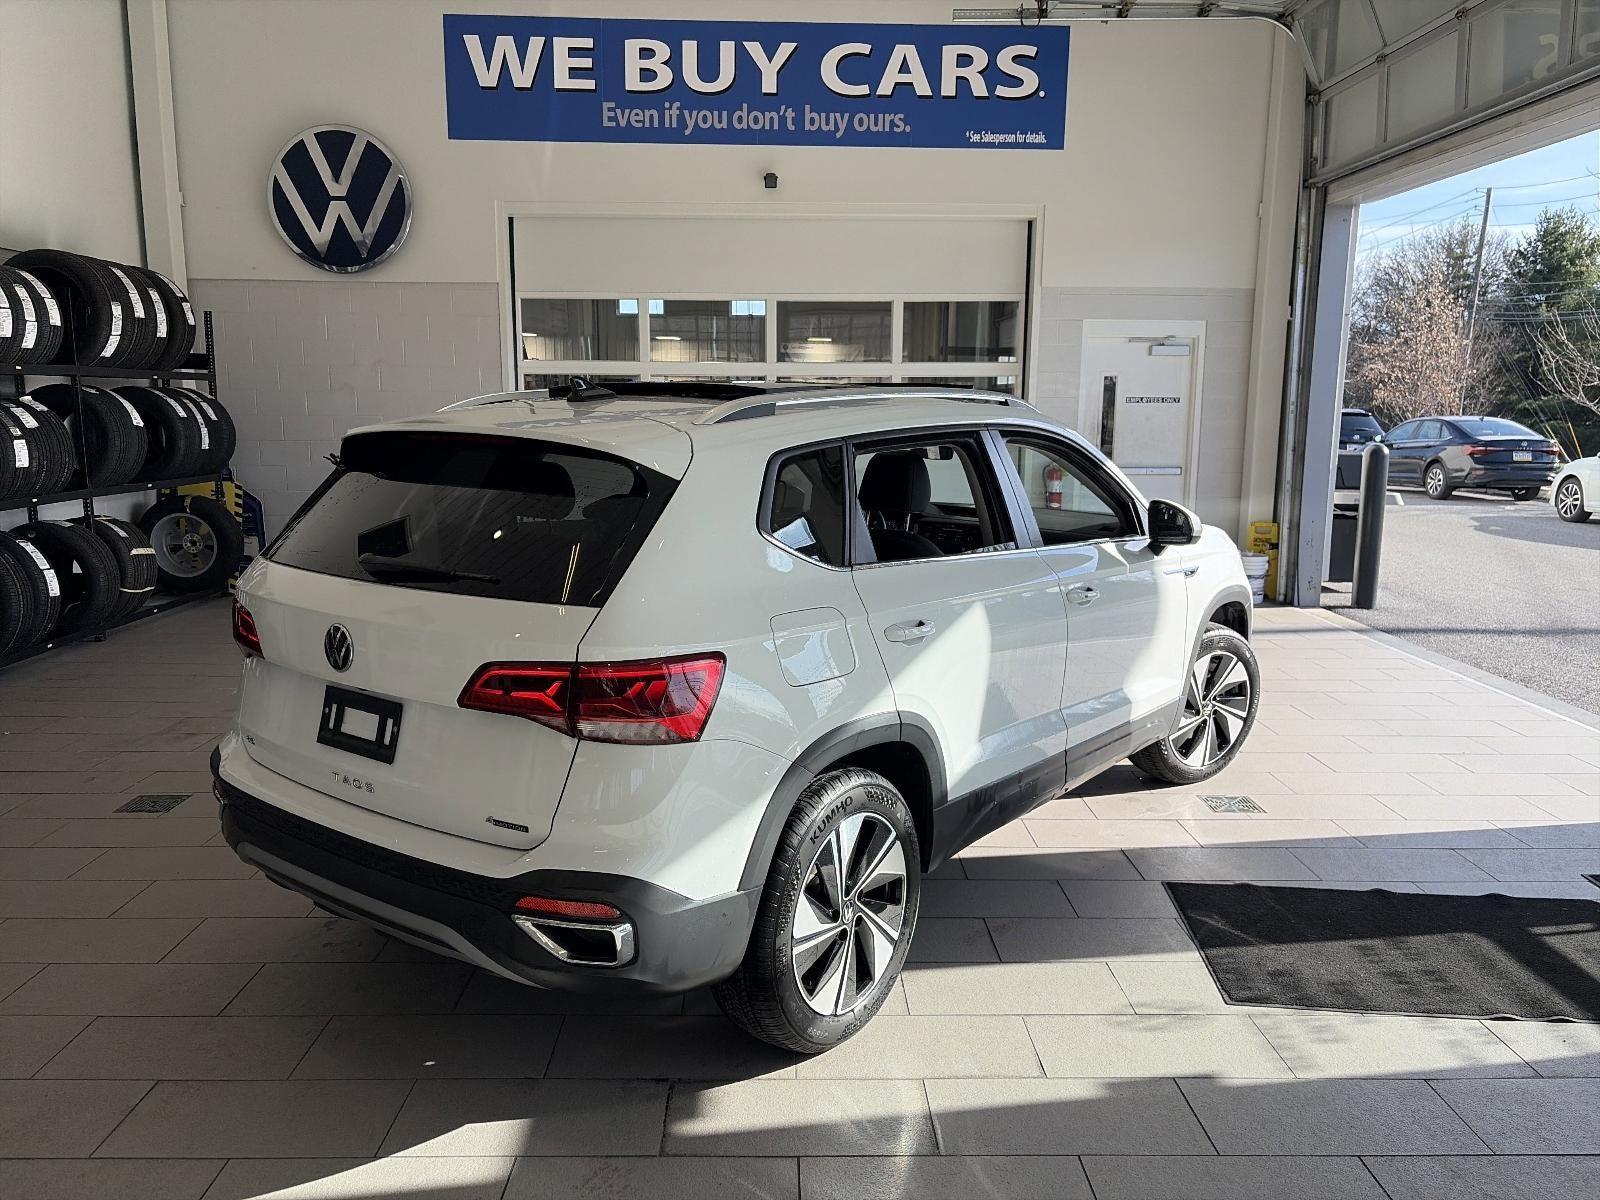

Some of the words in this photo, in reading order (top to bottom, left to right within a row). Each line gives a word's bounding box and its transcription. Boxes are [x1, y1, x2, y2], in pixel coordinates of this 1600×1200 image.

[463, 34, 597, 91] WE
[624, 38, 798, 94] BUY
[820, 42, 1046, 99] CARS.
[602, 101, 658, 128] Even
[664, 102, 679, 128] if
[684, 107, 728, 135] you
[732, 104, 795, 131] don't
[804, 105, 849, 138] buy
[853, 110, 911, 133] ours.
[981, 130, 1016, 145] Salesperson
[1016, 130, 1025, 143] for
[1026, 131, 1047, 144] details.
[331, 770, 375, 793] TAOS
[809, 795, 854, 845] KUMHO
